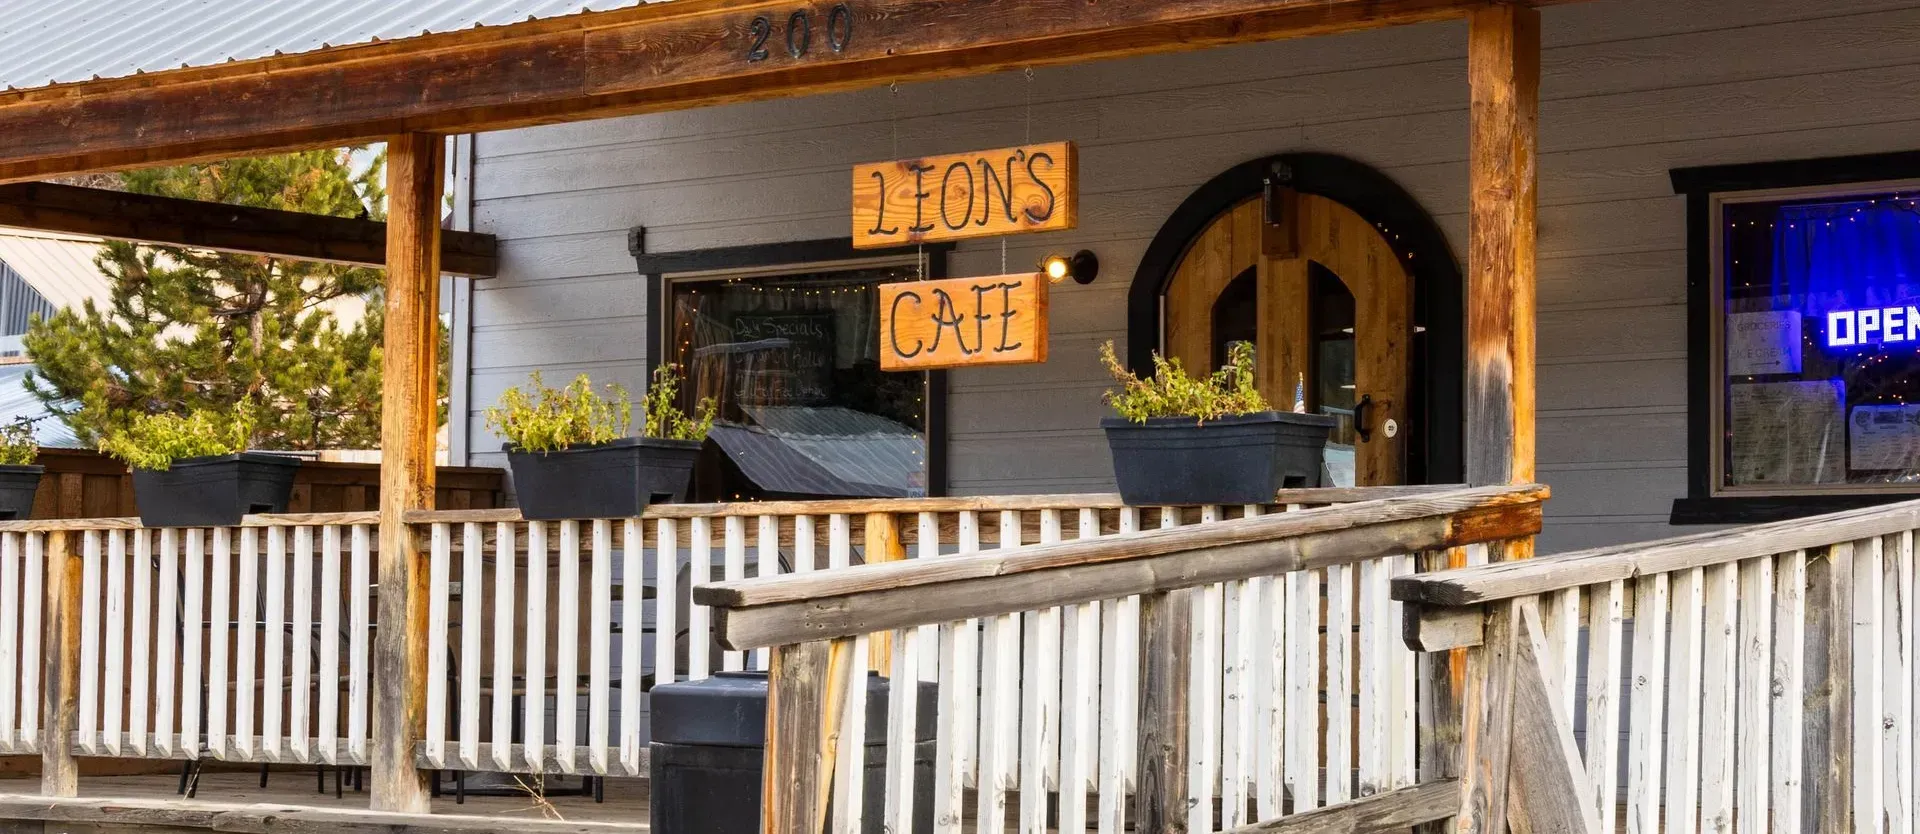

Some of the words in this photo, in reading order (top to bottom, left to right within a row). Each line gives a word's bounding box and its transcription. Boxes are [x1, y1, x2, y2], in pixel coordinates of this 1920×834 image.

[747, 3, 852, 63] 200
[868, 149, 1055, 235] LEON'S
[762, 316, 823, 338] Specials
[890, 280, 1022, 358] CAFE
[1737, 321, 1791, 332] GROCERIES
